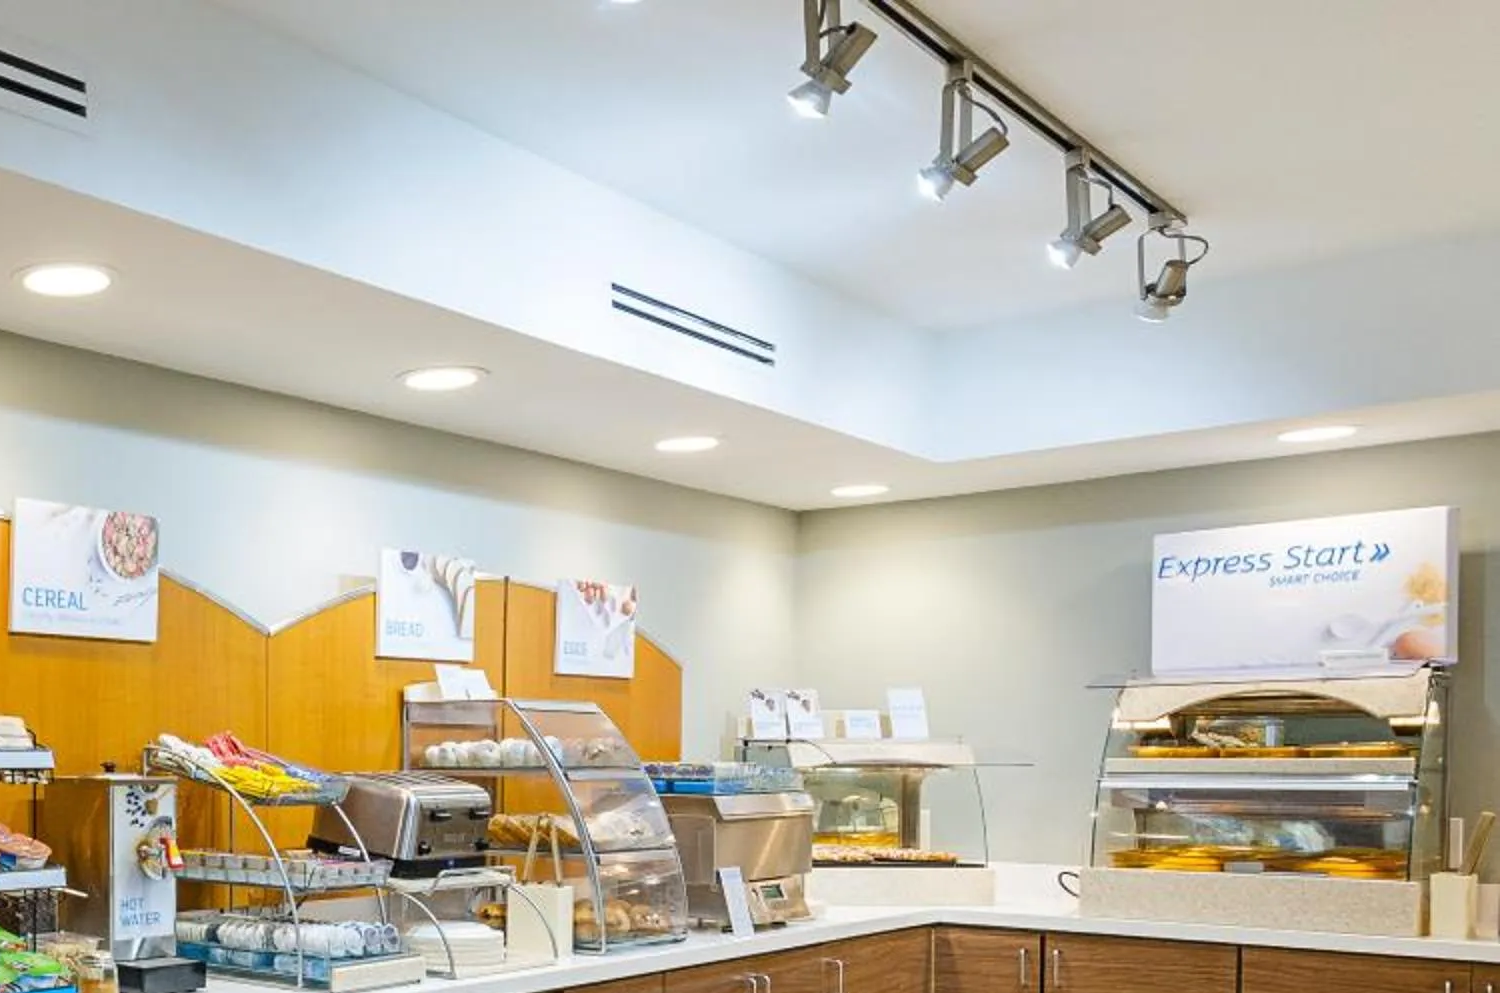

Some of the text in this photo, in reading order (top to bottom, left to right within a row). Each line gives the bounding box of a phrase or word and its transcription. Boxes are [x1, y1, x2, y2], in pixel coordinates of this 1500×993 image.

[1158, 540, 1367, 583] Express Start
[1269, 570, 1360, 588] SMART CHOICE
[21, 586, 90, 612] CEREAL
[385, 617, 426, 638] BREAD
[120, 898, 145, 911] HOT
[119, 910, 162, 927] WATER
